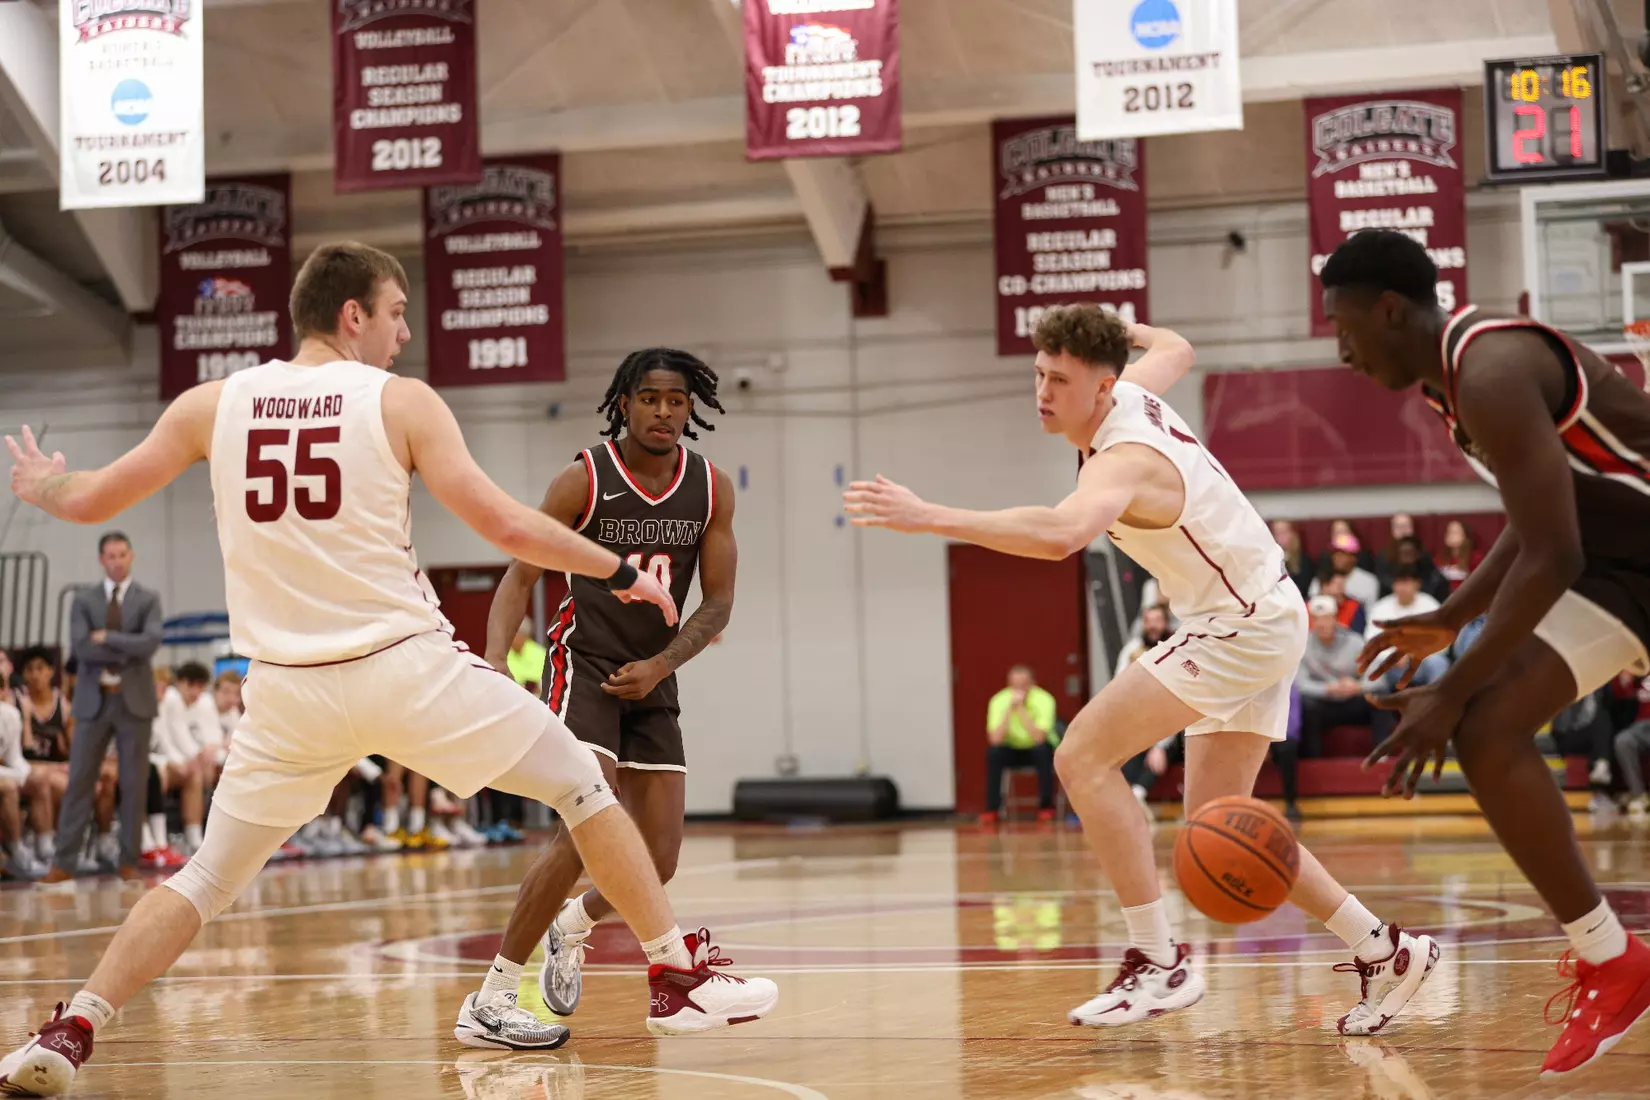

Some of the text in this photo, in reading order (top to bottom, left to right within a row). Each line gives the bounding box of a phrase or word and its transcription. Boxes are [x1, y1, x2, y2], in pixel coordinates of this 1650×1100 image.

[354, 27, 455, 49] VOLLEYBALL
[361, 62, 449, 86] REGULAR
[762, 59, 883, 84] TOURNAMENT
[1092, 52, 1220, 77] TOURNAMENT
[368, 84, 443, 107] SEASON
[763, 77, 883, 103] CHAMPIONS
[1123, 82, 1195, 113] 2012
[350, 103, 462, 129] CHAMPIONS
[786, 104, 861, 140] 2012
[75, 131, 189, 151] TOURNAMENT
[1512, 105, 1582, 164] 21
[372, 136, 442, 171] 2012
[99, 159, 166, 186] 2004
[1359, 160, 1411, 180] MEN'S
[1045, 183, 1095, 202] MEN'S
[1334, 175, 1437, 198] BASKETBALL
[1021, 198, 1120, 220] BASKETBALL
[1340, 206, 1434, 232] REGULAR
[445, 231, 542, 254] VOLLEYBALL
[1026, 228, 1116, 252] REGULAR
[179, 248, 271, 270] VOLLEYBALL
[1033, 250, 1110, 272] SEASON
[452, 265, 537, 289] REGULAR
[999, 268, 1146, 296] CO-CHAMPIONS
[458, 286, 530, 308] SEASON
[174, 311, 278, 332] TOURNAMENT
[441, 304, 549, 330] CHAMPIONS
[174, 328, 278, 350] CHAMPIONS
[468, 336, 528, 369] 1991
[252, 394, 343, 420] WOODWARD
[245, 426, 342, 523] 55
[598, 518, 702, 546] BROWN
